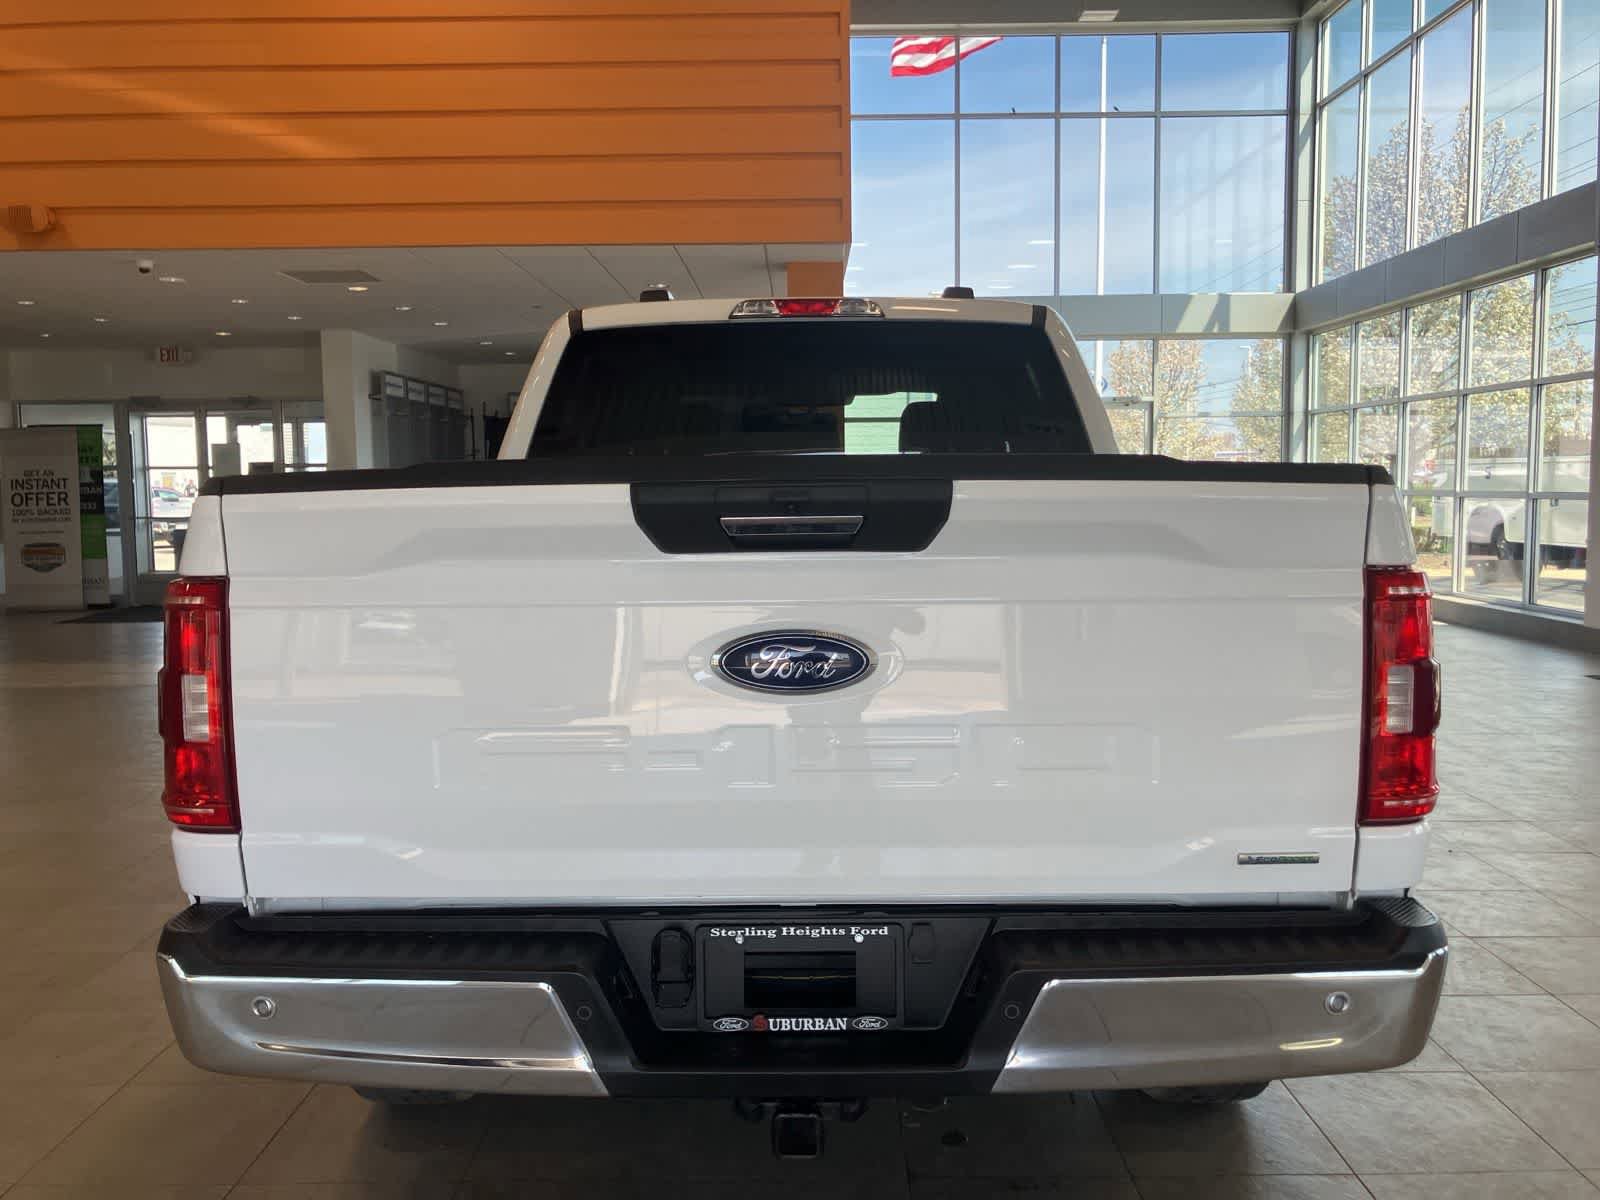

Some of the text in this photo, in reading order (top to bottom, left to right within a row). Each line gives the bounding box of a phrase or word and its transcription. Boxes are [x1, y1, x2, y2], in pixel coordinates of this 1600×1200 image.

[160, 346, 178, 362] EXIT
[10, 478, 69, 491] INSTANT
[10, 491, 70, 507] OFFER
[751, 644, 838, 680] Ford
[710, 926, 889, 938] Sterling Heights Ford
[752, 1015, 848, 1031] SUBURBAN
